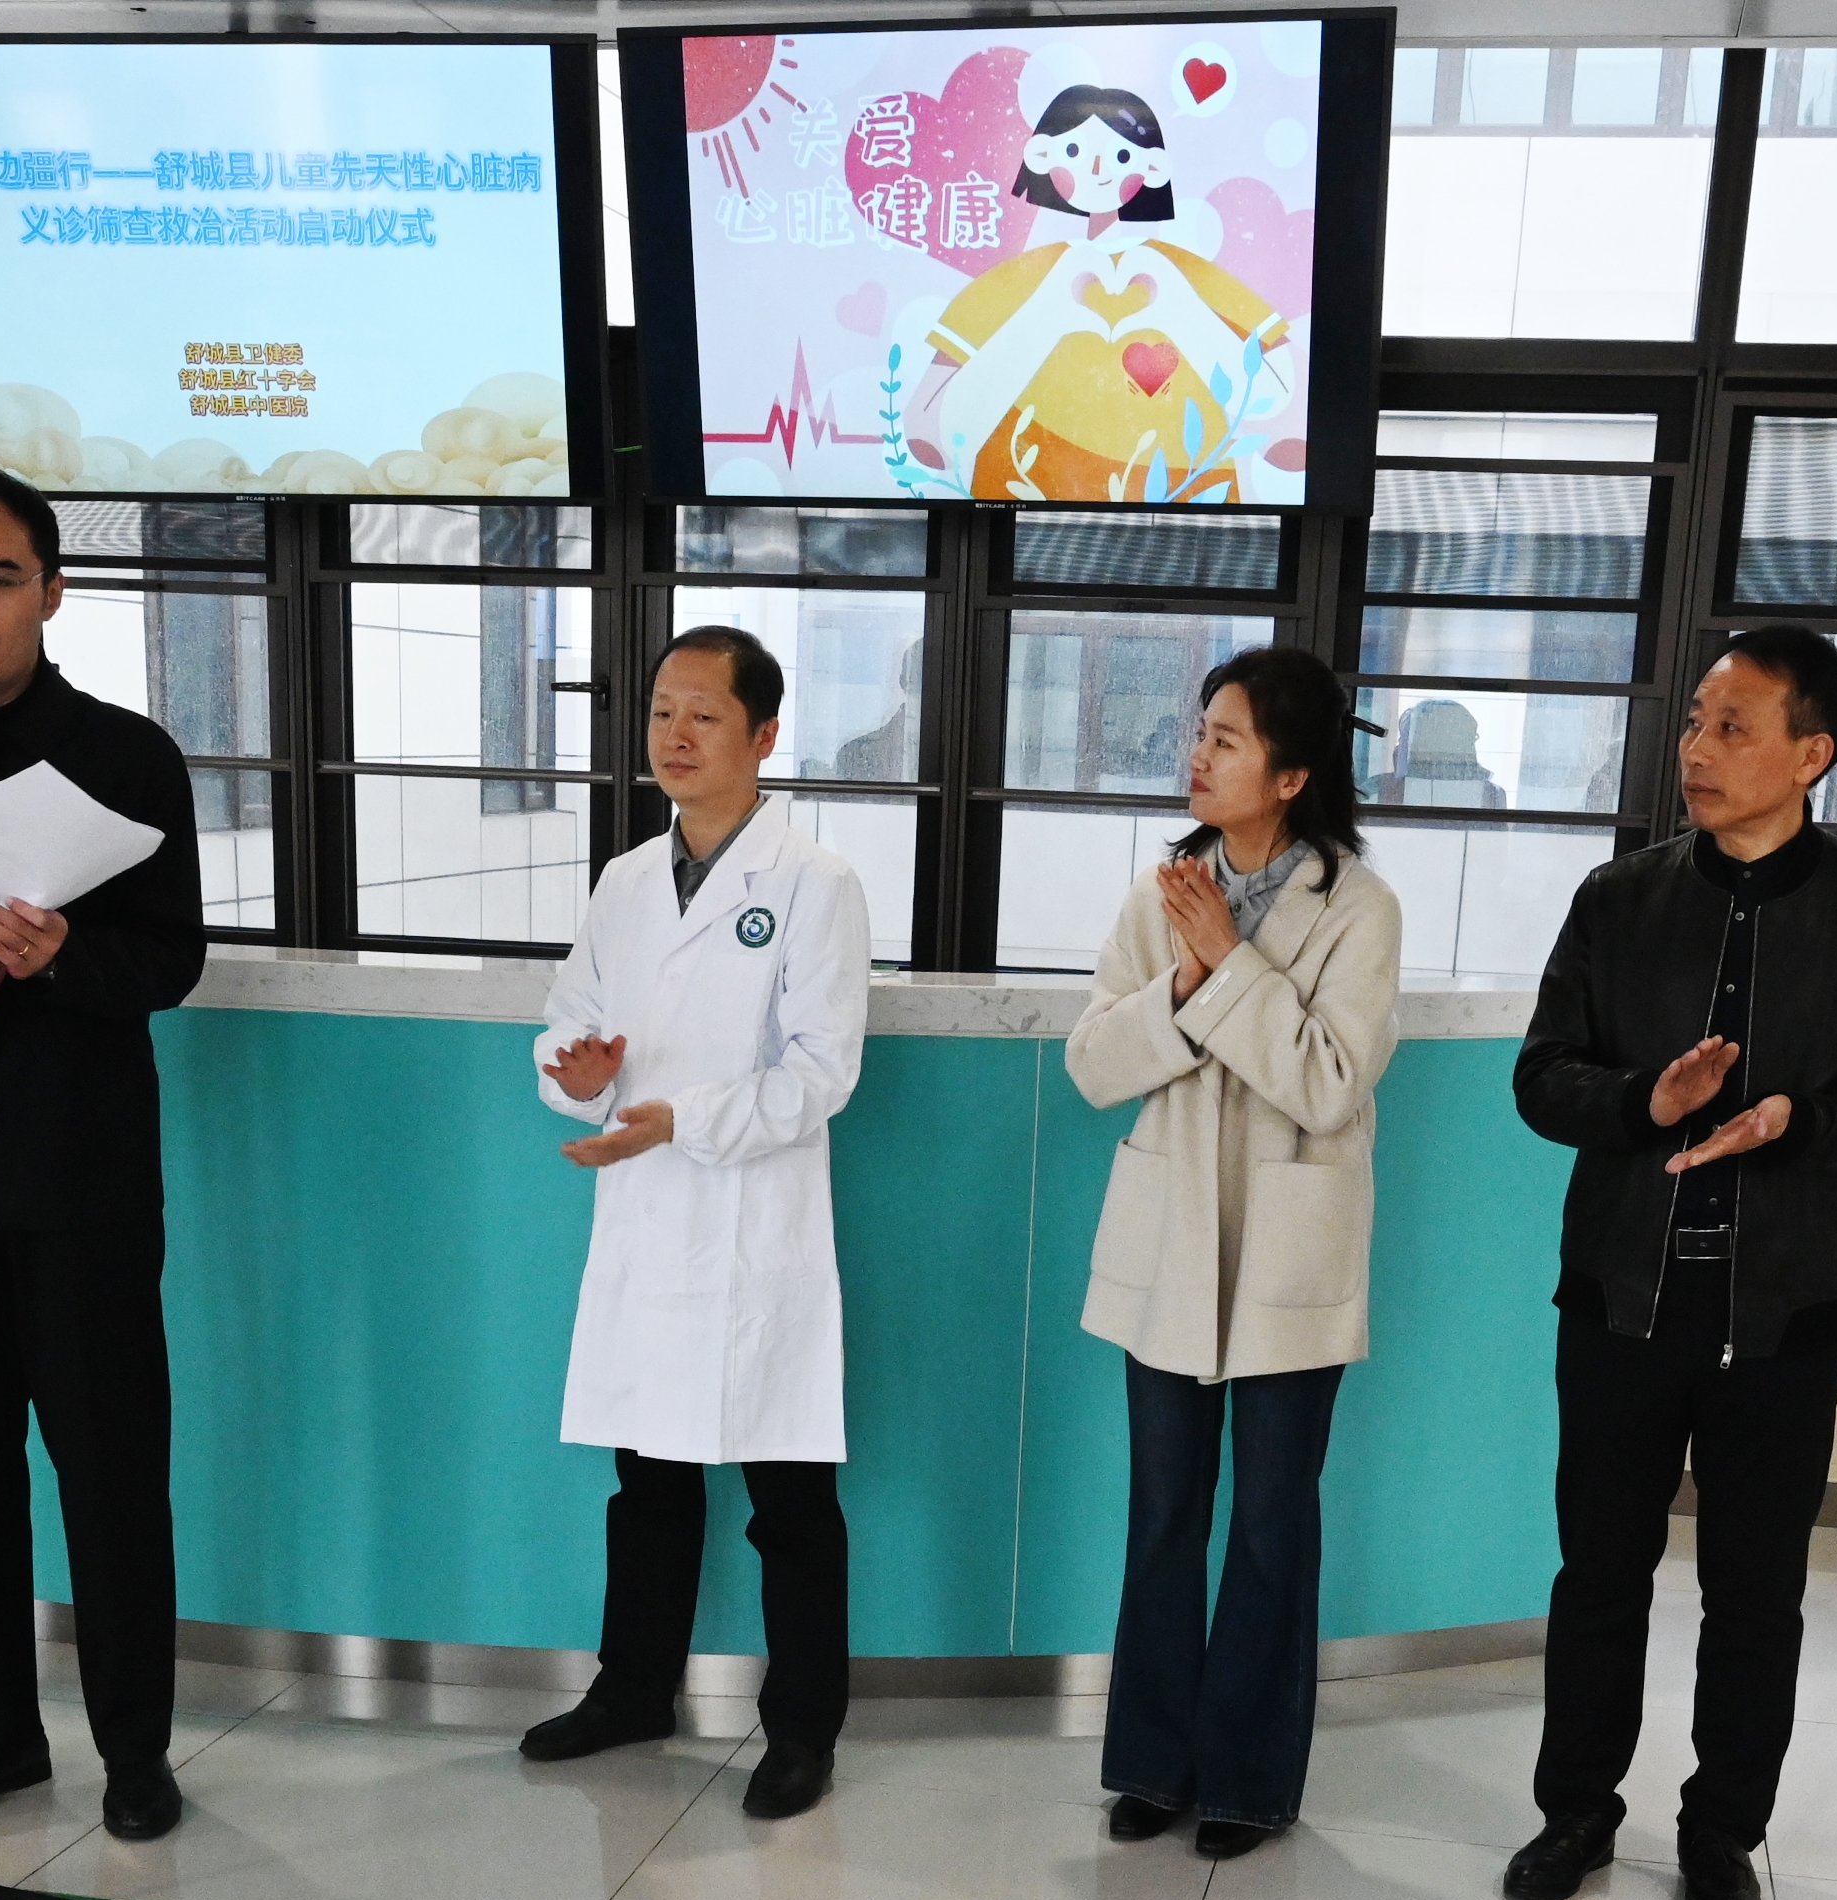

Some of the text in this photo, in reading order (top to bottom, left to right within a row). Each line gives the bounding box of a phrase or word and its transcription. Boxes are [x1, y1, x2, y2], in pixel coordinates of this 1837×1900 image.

[789, 92, 916, 169] 关爱
[20, 205, 437, 246] 义诊筛查救治活动启动仪式
[715, 171, 1004, 254] 心脏健康
[184, 342, 304, 365] 舒城县卫健委
[178, 368, 317, 391] 舒城县红十字会
[189, 394, 309, 417] 舒城县中医院
